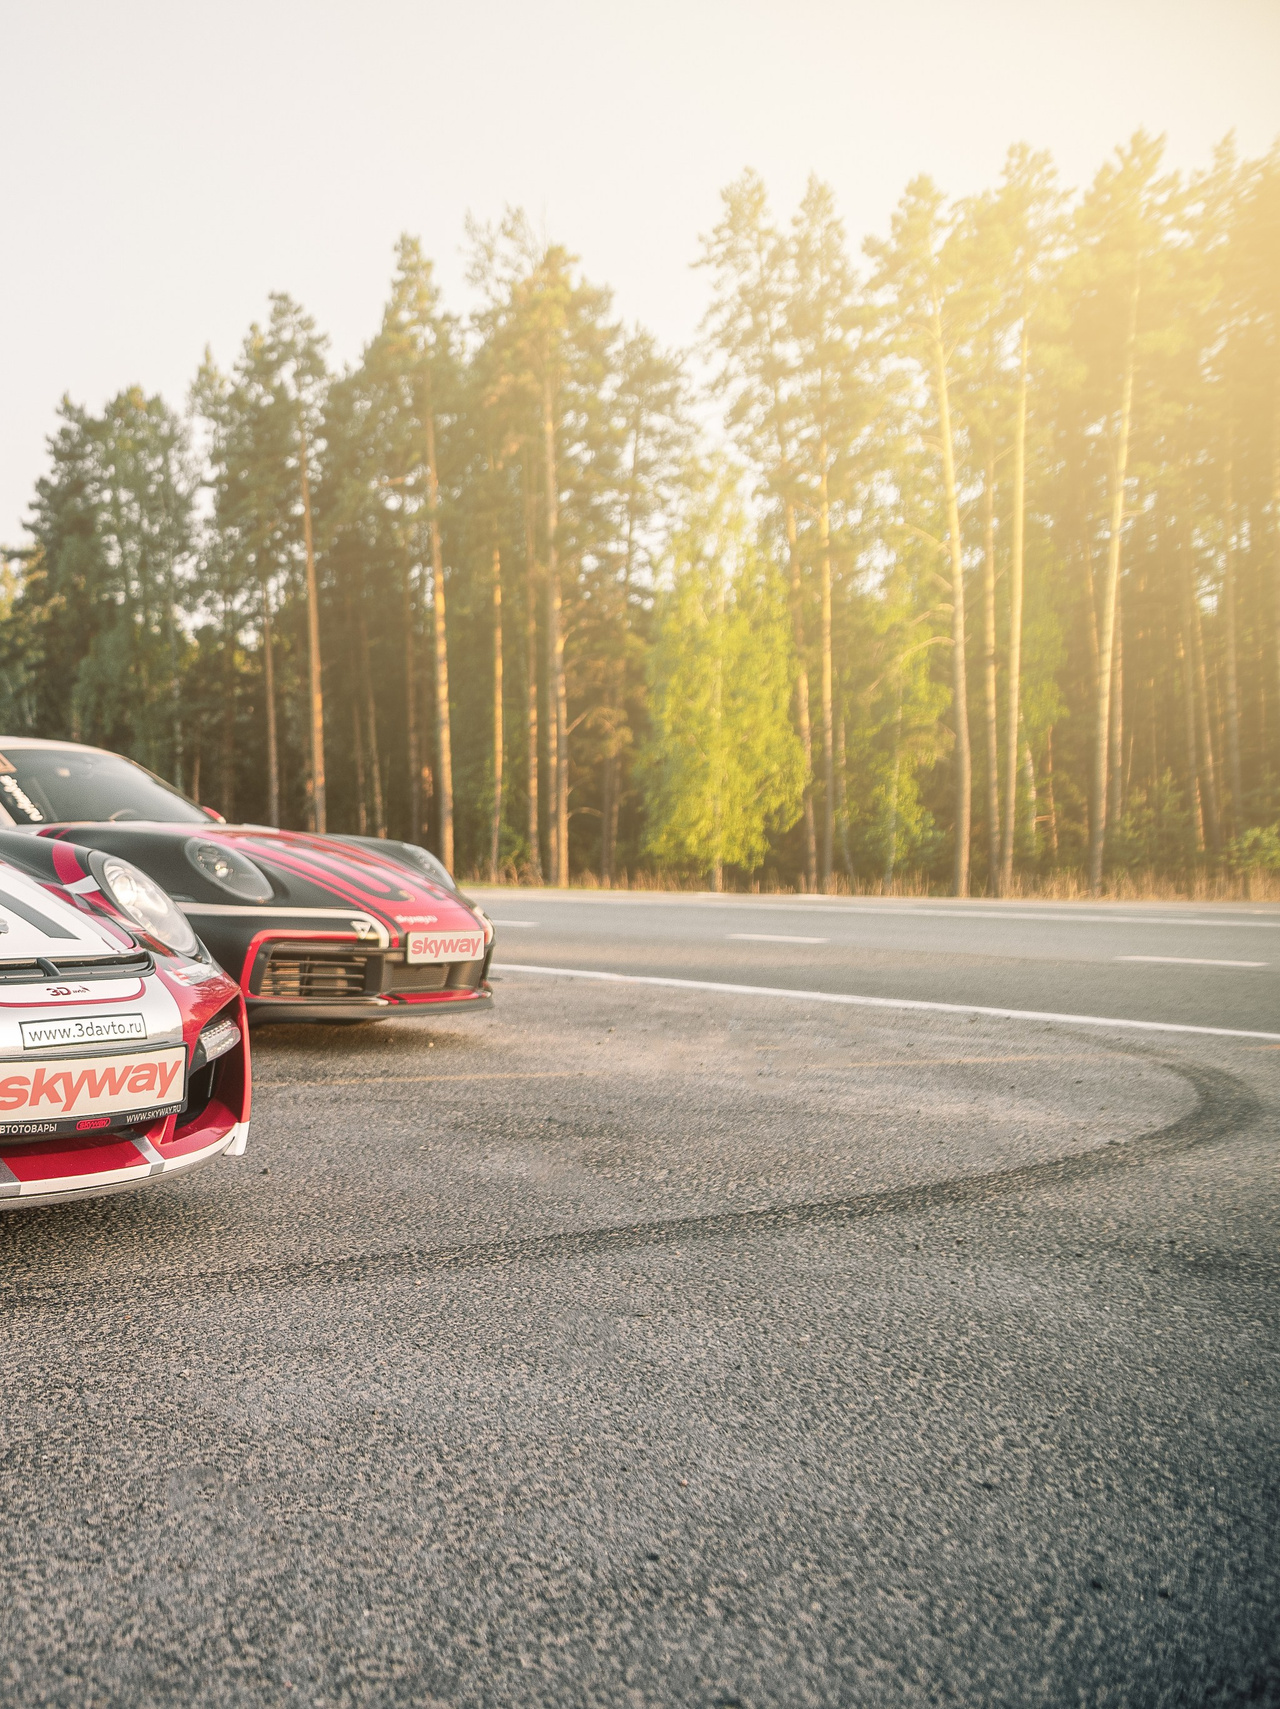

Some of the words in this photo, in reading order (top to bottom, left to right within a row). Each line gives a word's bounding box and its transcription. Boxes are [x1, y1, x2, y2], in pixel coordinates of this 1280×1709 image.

[411, 937, 482, 958] skyway
[28, 1021, 142, 1042] www.3davto.ru
[126, 1105, 182, 1123] WWW.SKYWAY.RU
